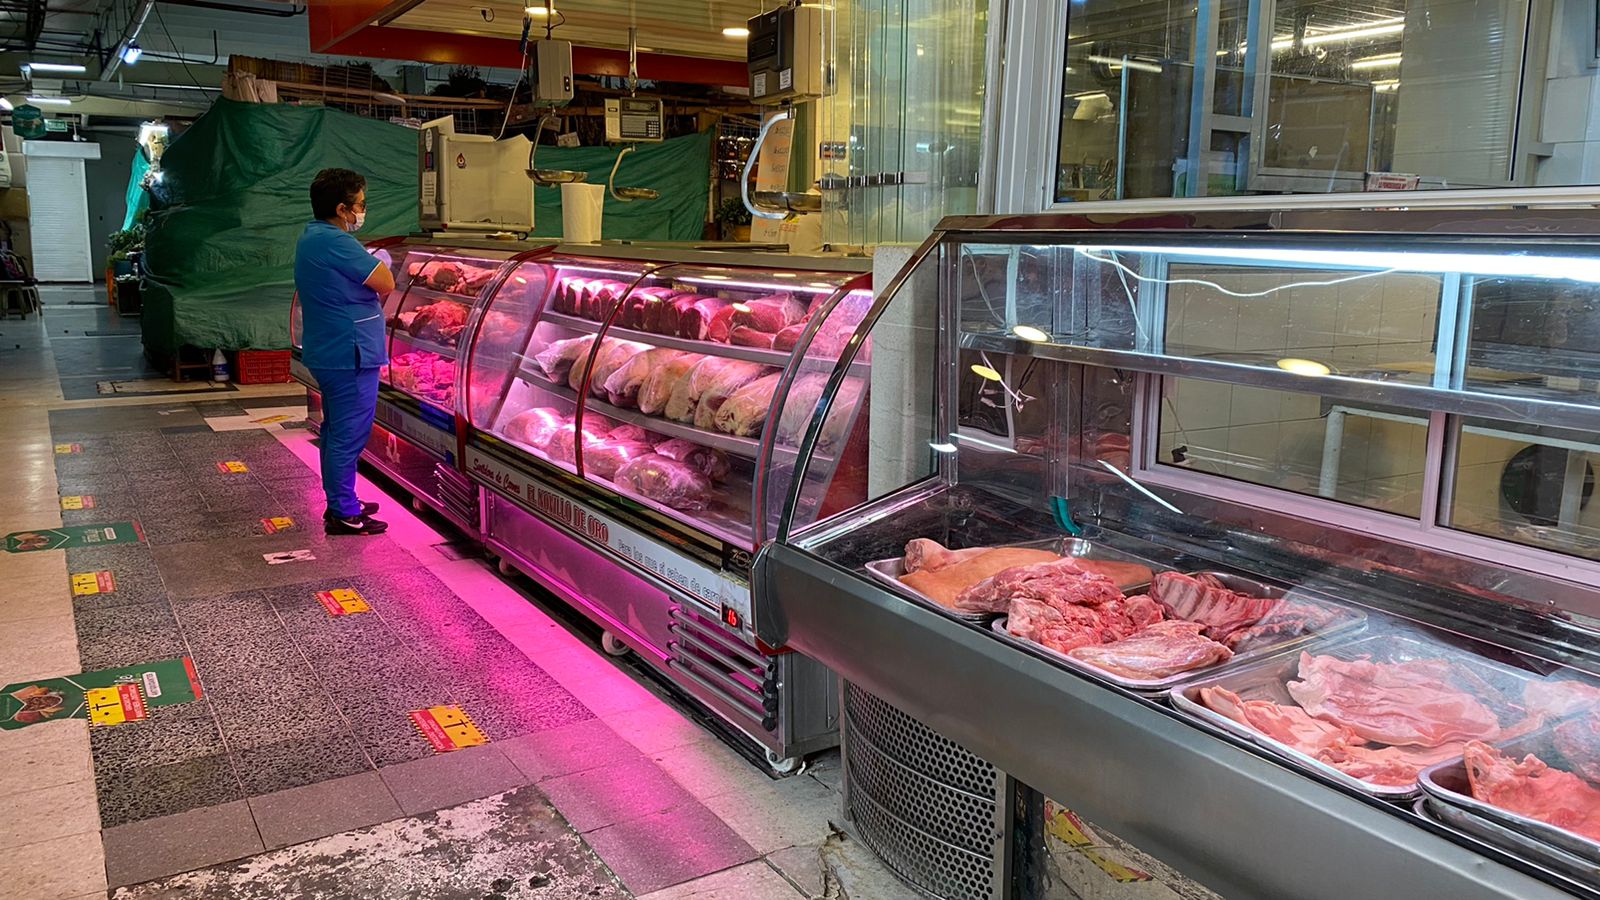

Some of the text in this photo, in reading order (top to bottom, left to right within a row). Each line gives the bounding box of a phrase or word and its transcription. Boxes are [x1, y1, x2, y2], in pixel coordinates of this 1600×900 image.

[527, 484, 609, 545] EL NOVILLO DE ORO
[619, 539, 632, 558] Para
[633, 546, 643, 564] los
[667, 567, 689, 588] saben
[690, 577, 700, 593] de
[727, 607, 737, 626] 16
